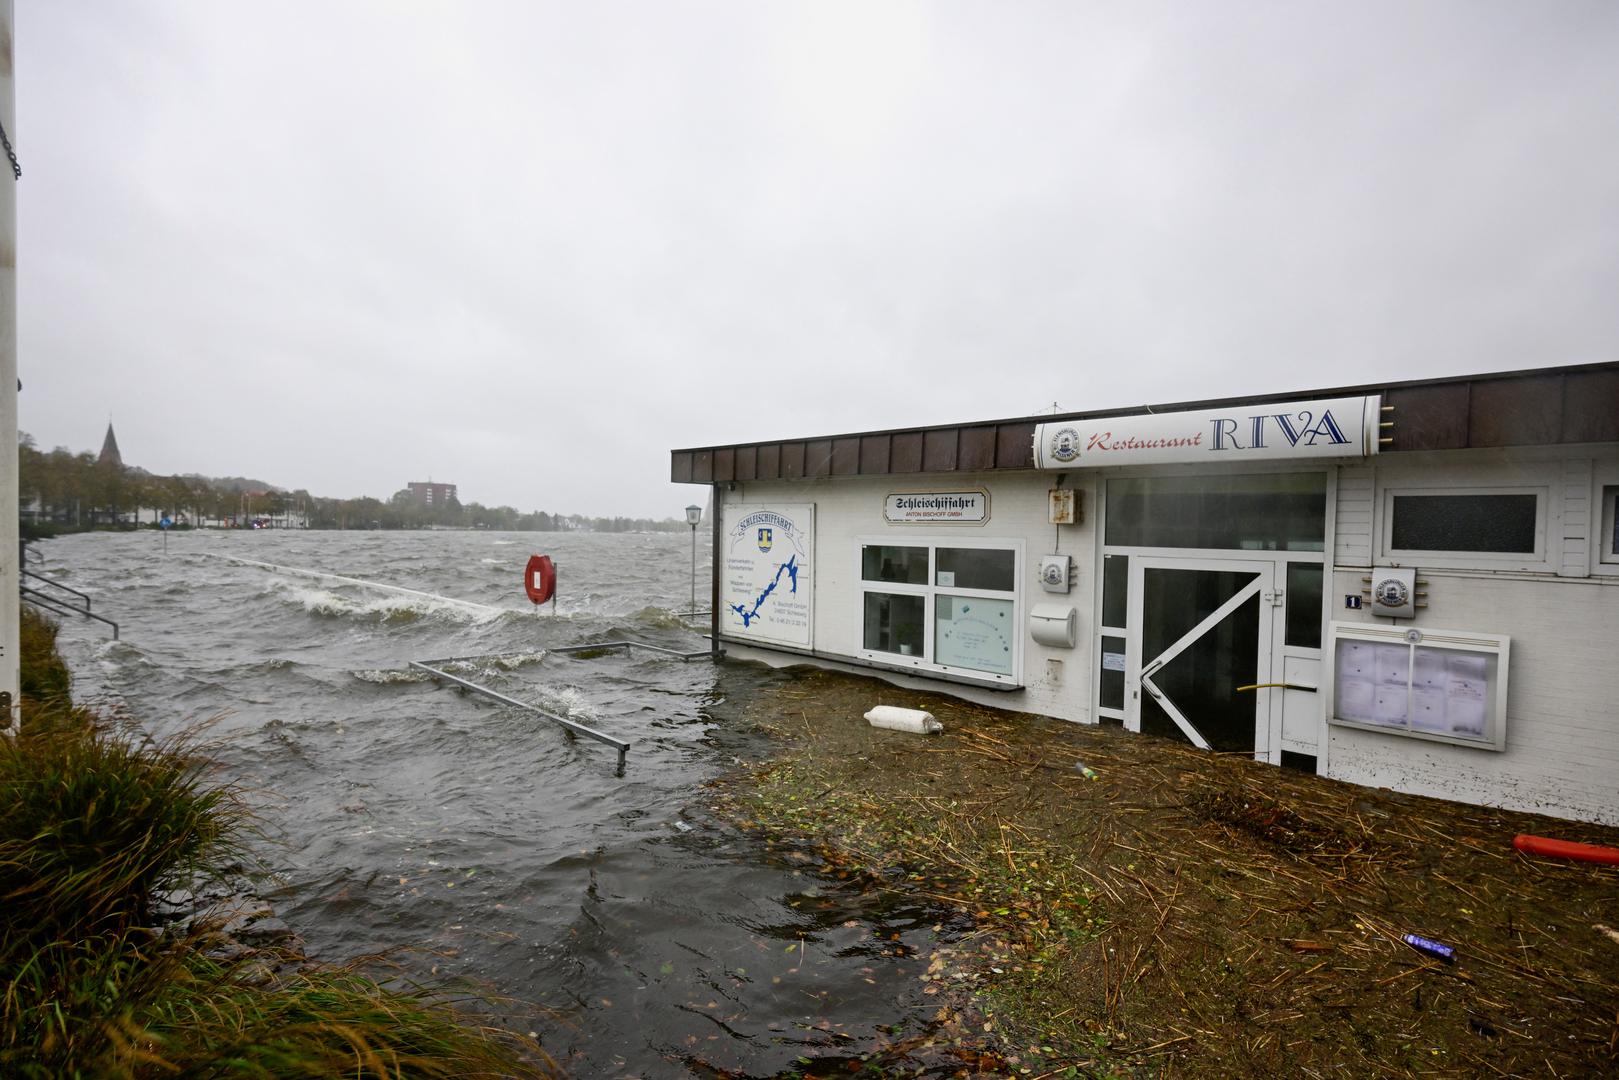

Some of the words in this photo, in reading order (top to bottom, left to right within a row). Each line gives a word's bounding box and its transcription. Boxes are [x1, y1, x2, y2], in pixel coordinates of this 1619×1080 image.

[1087, 431, 1202, 451] Restaurant
[1208, 409, 1352, 451] RIVA
[740, 513, 793, 531] SCHLEISCHIFFAHRT
[1350, 597, 1356, 608] 1
